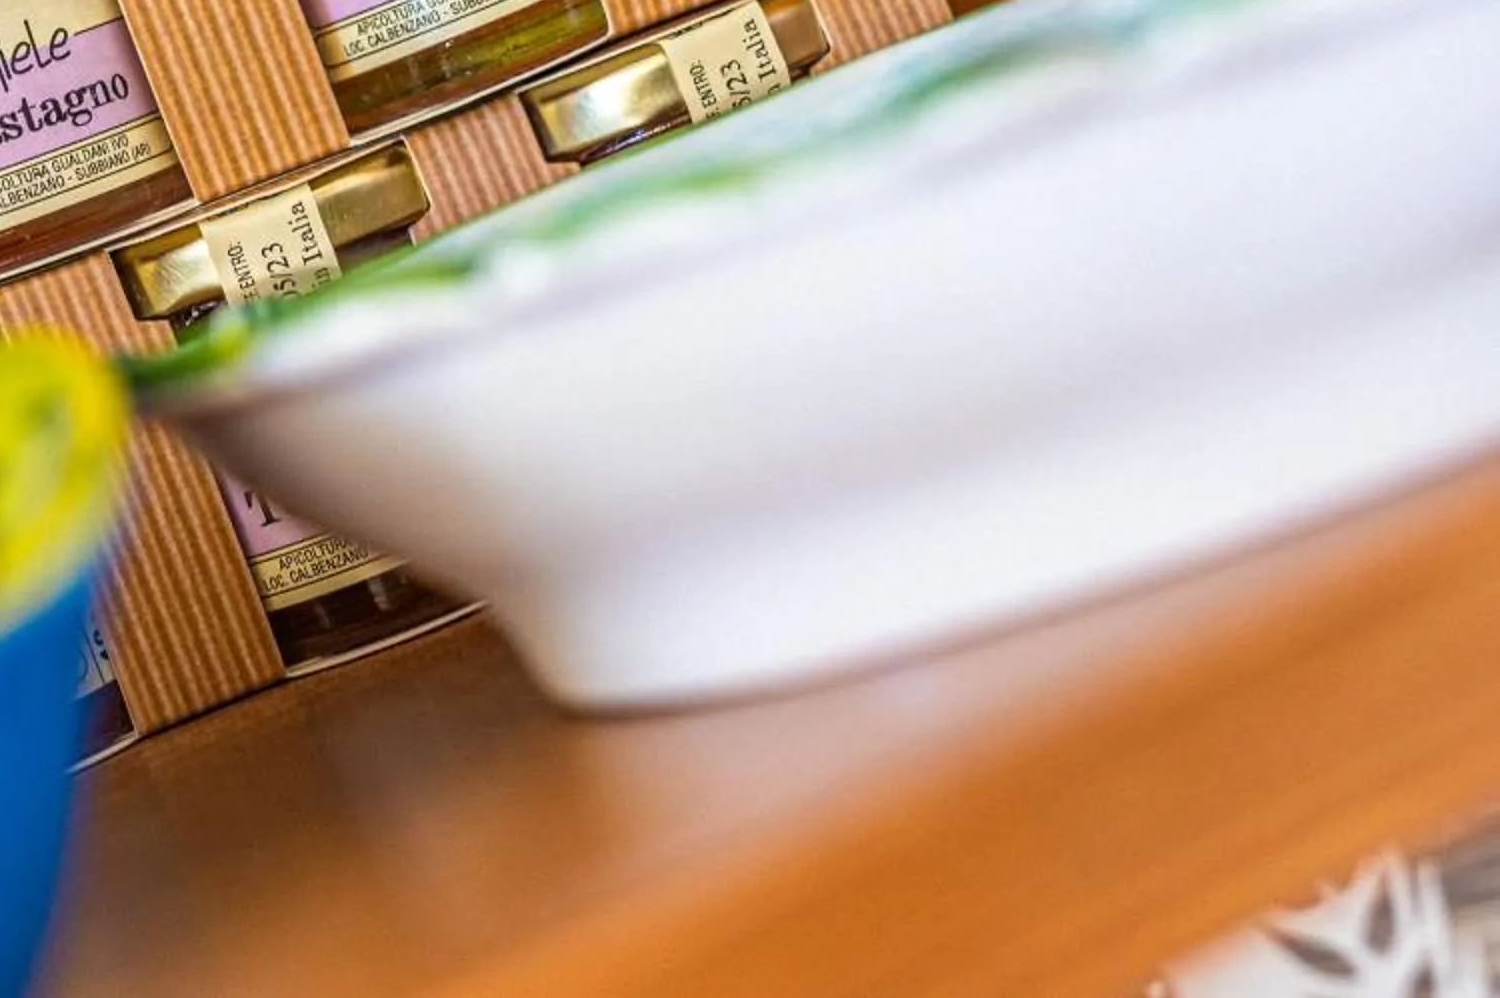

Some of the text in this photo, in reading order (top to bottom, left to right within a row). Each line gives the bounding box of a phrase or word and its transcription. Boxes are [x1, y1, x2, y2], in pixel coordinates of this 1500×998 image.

[357, 0, 424, 35] APICOLTURA
[366, 12, 442, 48] CALBENZANO
[742, 18, 778, 83] Italia
[51, 143, 110, 174] GUALDANI
[111, 134, 129, 153] IVO
[75, 155, 131, 181] SUBBIANO
[287, 201, 323, 267] Italia
